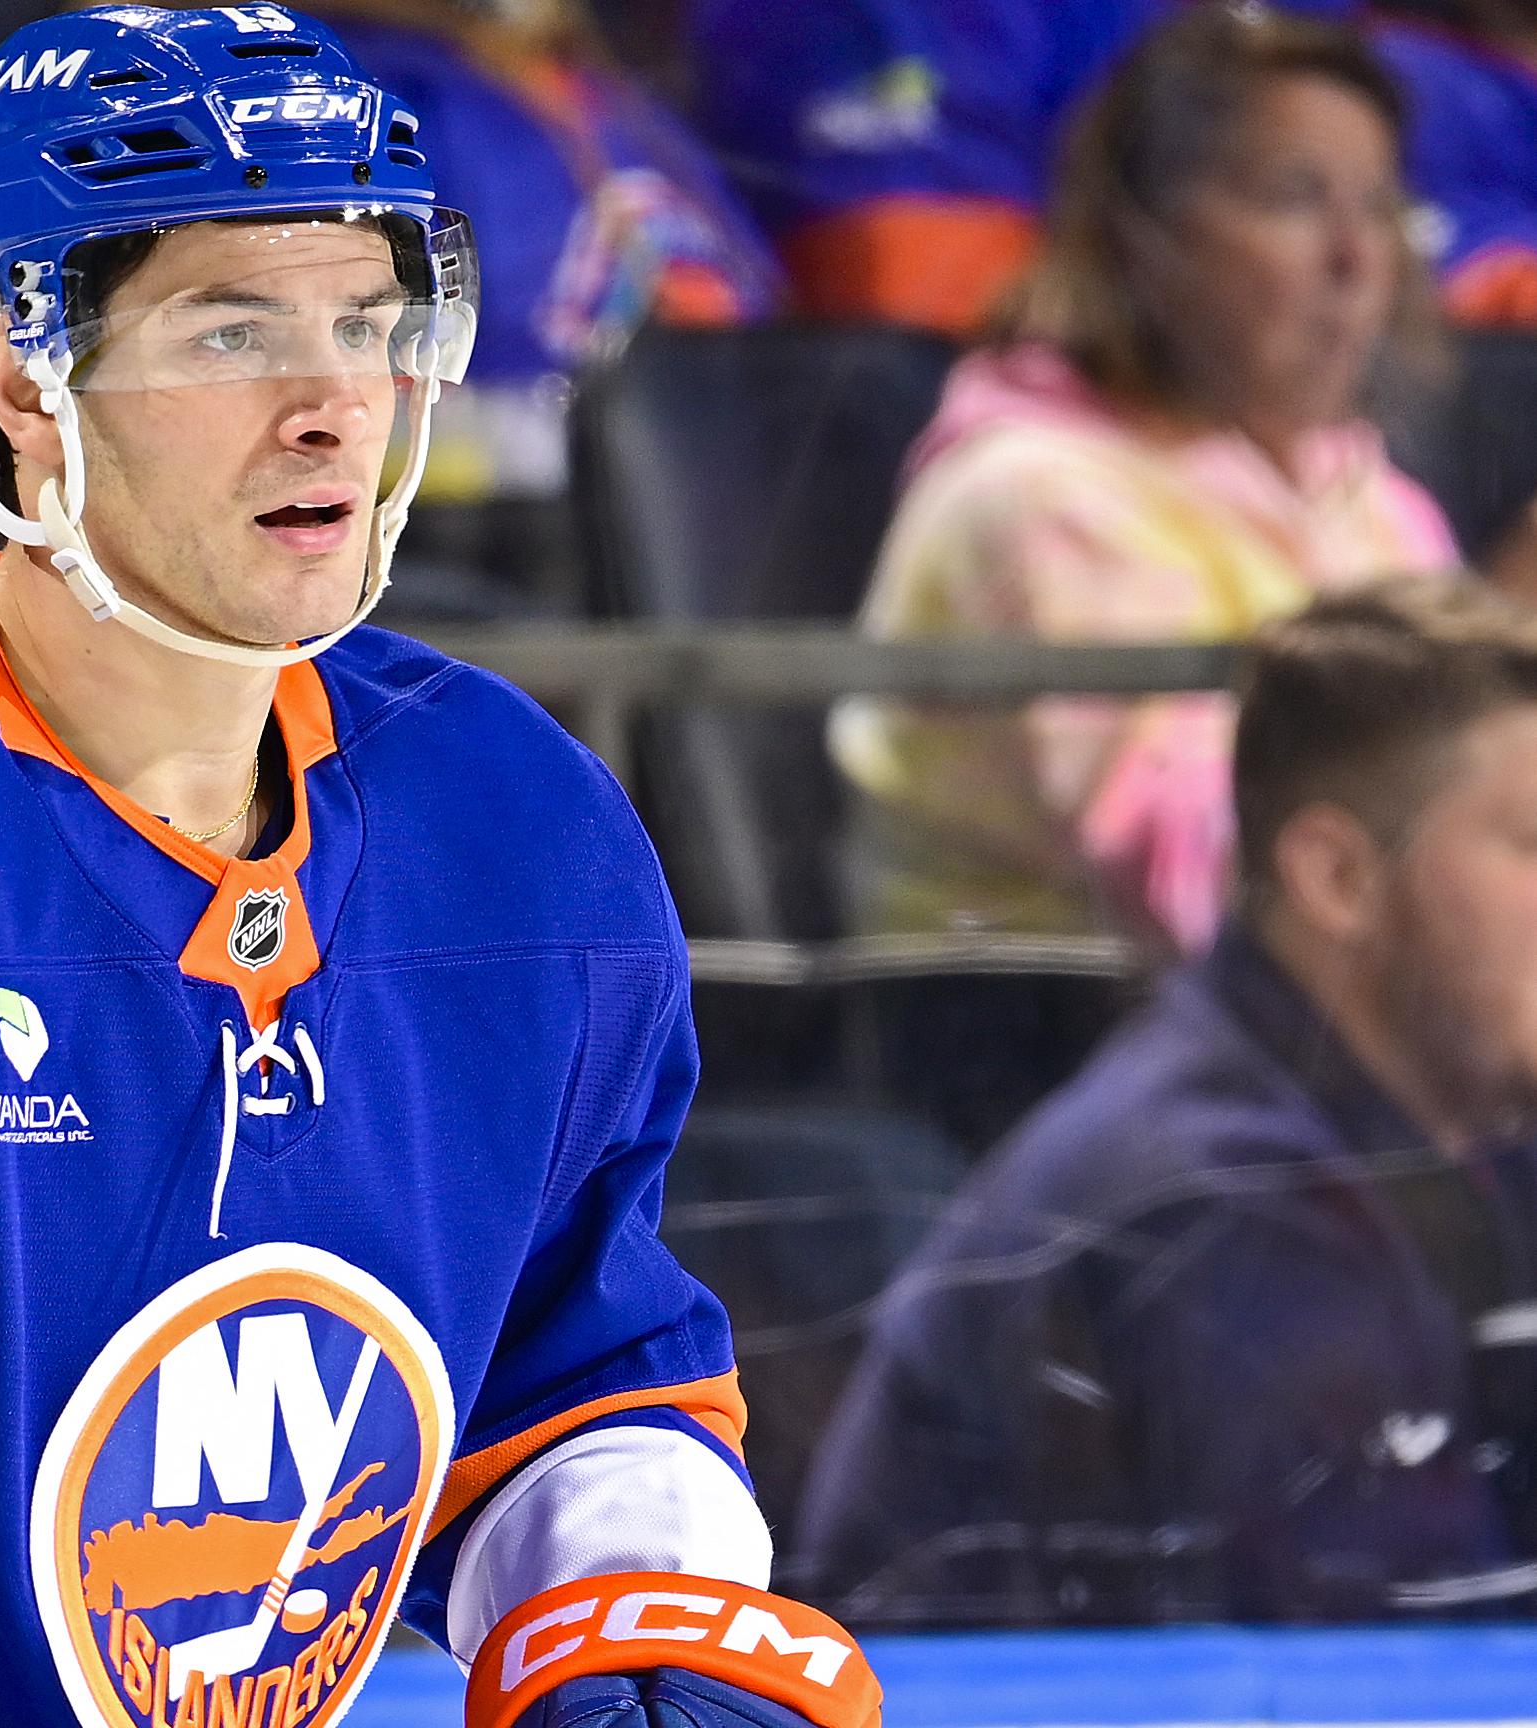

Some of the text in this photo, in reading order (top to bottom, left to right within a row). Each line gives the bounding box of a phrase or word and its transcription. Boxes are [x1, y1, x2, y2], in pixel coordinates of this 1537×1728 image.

[211, 6, 296, 33] 13
[230, 95, 363, 123] CCM
[240, 907, 277, 953] NHL
[152, 1312, 381, 1508] NY
[109, 1566, 378, 1728] ISLANDERS
[500, 1591, 852, 1692] CCM
